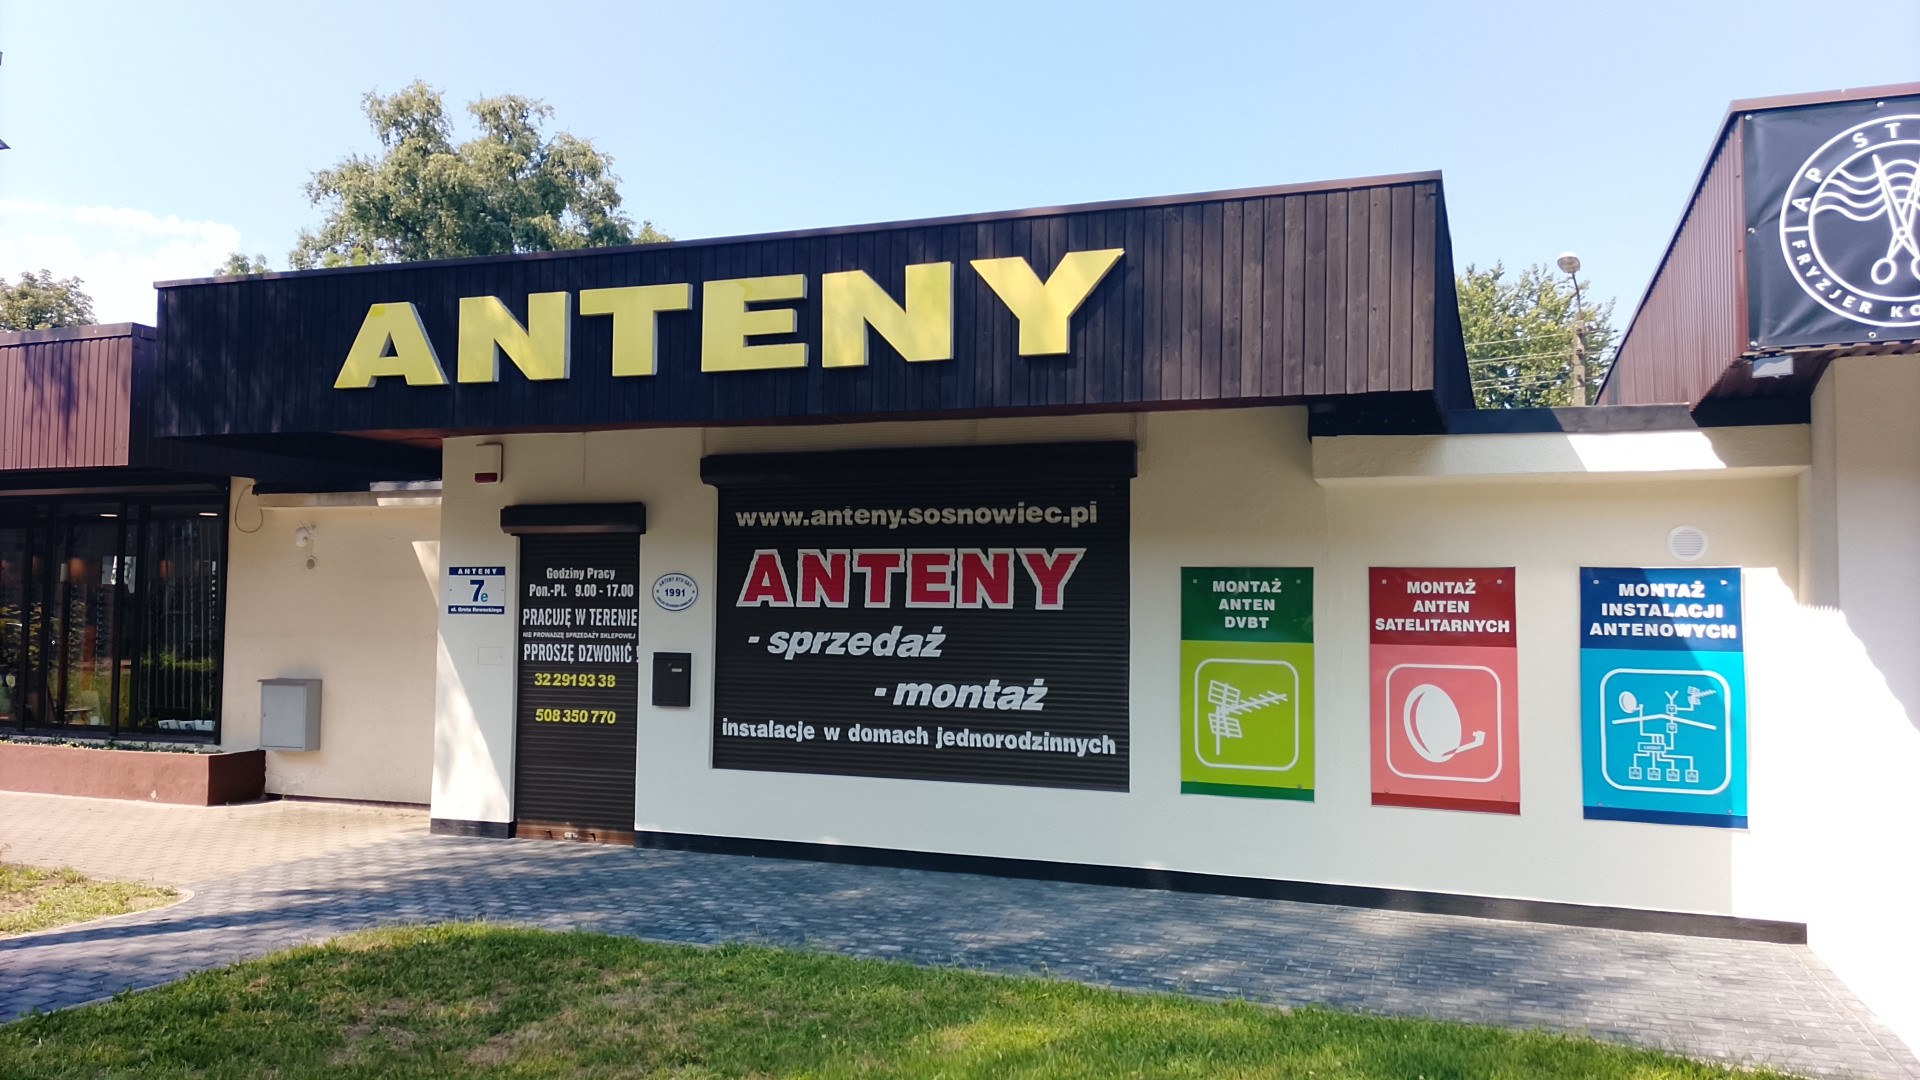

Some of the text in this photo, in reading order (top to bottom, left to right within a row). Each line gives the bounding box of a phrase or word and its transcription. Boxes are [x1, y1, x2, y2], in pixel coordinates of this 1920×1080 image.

[1792, 239, 1874, 315] FRYZJER
[333, 248, 1125, 388] ANTENY
[546, 567, 616, 580] Godziny Pracy
[736, 548, 1087, 610] ANTENY
[575, 584, 597, 597] 9.00
[606, 584, 635, 597] 17.00
[665, 588, 685, 597] 1991
[1212, 578, 1282, 593] MONTAŻ
[1406, 579, 1476, 594] MONTAŻ
[1618, 581, 1705, 598] MONTAŻ
[1218, 599, 1275, 611] ANTEN
[1413, 600, 1470, 613] ANTEN
[1601, 603, 1723, 618] INSTALACJI
[522, 608, 638, 628] PRACUJĘ W TERENIE
[1224, 616, 1269, 629] DVBT
[1375, 618, 1510, 633] SATELITARNYCH
[533, 631, 564, 639] PROWADZĘ
[1589, 622, 1737, 639] ANTENOWYCH
[767, 626, 947, 661] sprzedaż
[523, 643, 575, 664] PPROSZĘ
[578, 643, 632, 663] DZWONIĆ
[892, 678, 1049, 711] montaż
[535, 708, 616, 724] 508 350 770
[823, 727, 841, 741] w
[848, 723, 929, 745] domach
[935, 726, 1117, 757] jednorodzinnych
